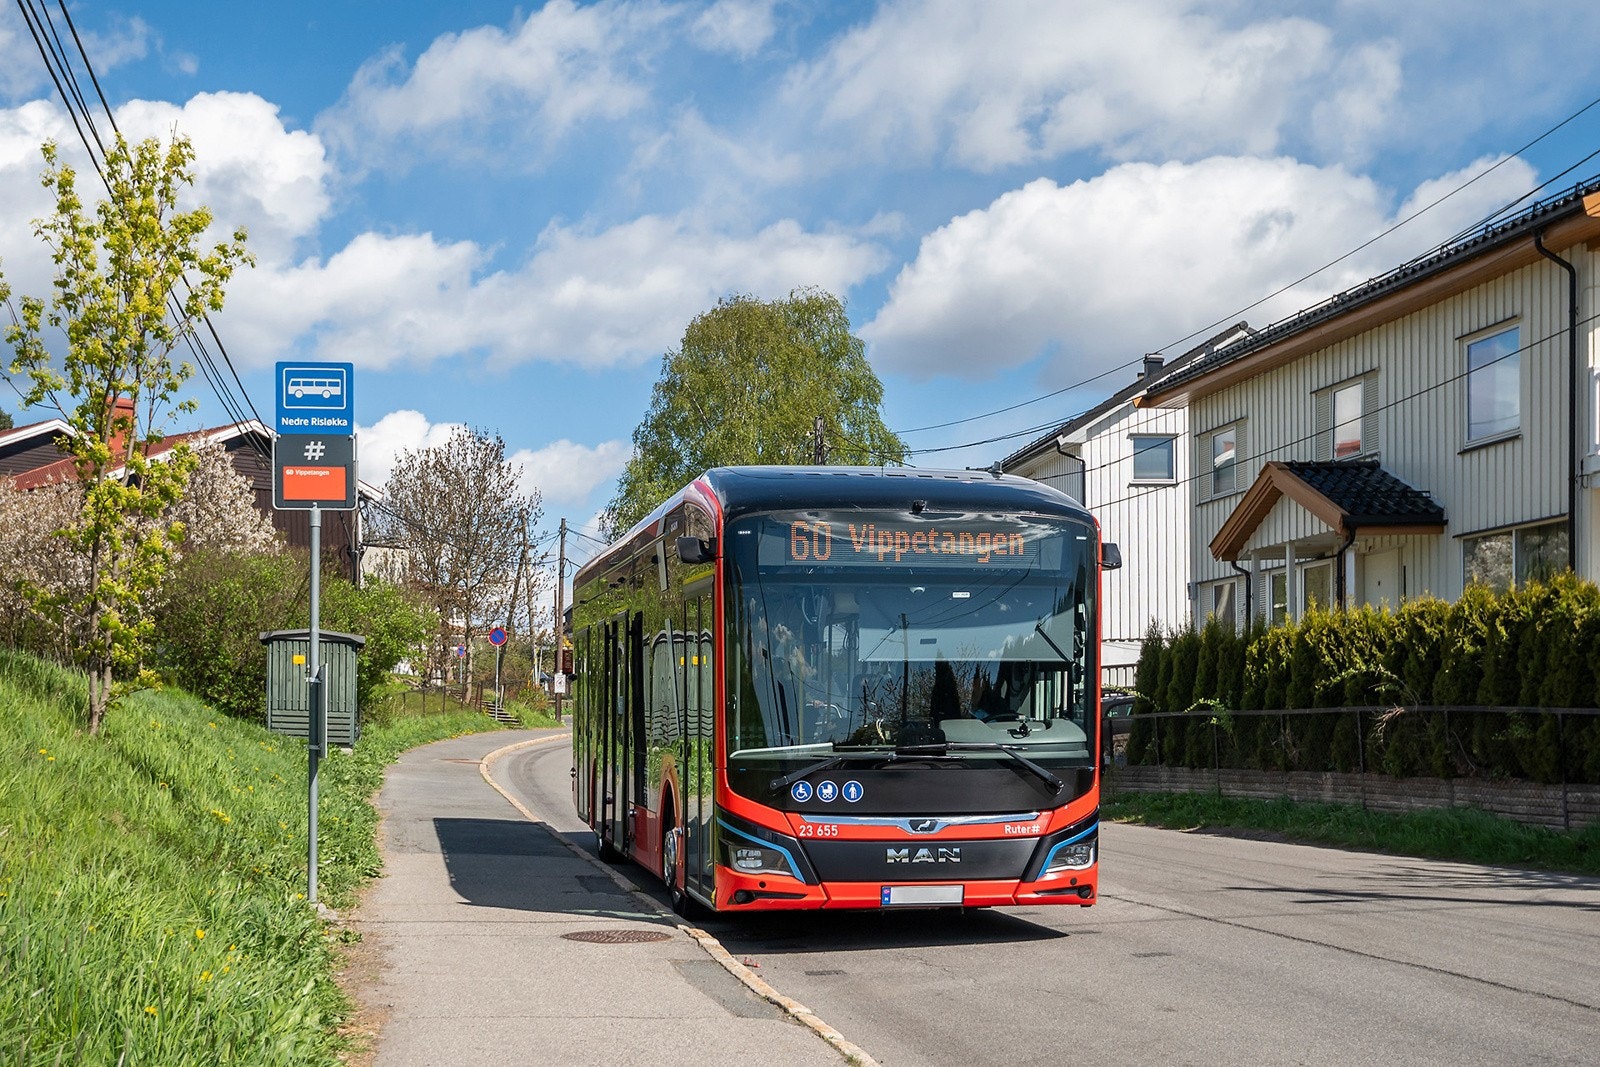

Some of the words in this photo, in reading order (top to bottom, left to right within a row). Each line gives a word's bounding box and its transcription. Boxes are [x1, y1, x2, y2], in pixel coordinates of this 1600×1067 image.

[281, 417, 309, 426] Nedre
[311, 417, 348, 426] Risløkka
[790, 520, 831, 561] 60
[848, 523, 1025, 563] Vippetangen
[799, 825, 813, 837] 23
[817, 825, 838, 837] 655
[1004, 824, 1040, 834] Ruter#
[886, 848, 962, 864] MAN
